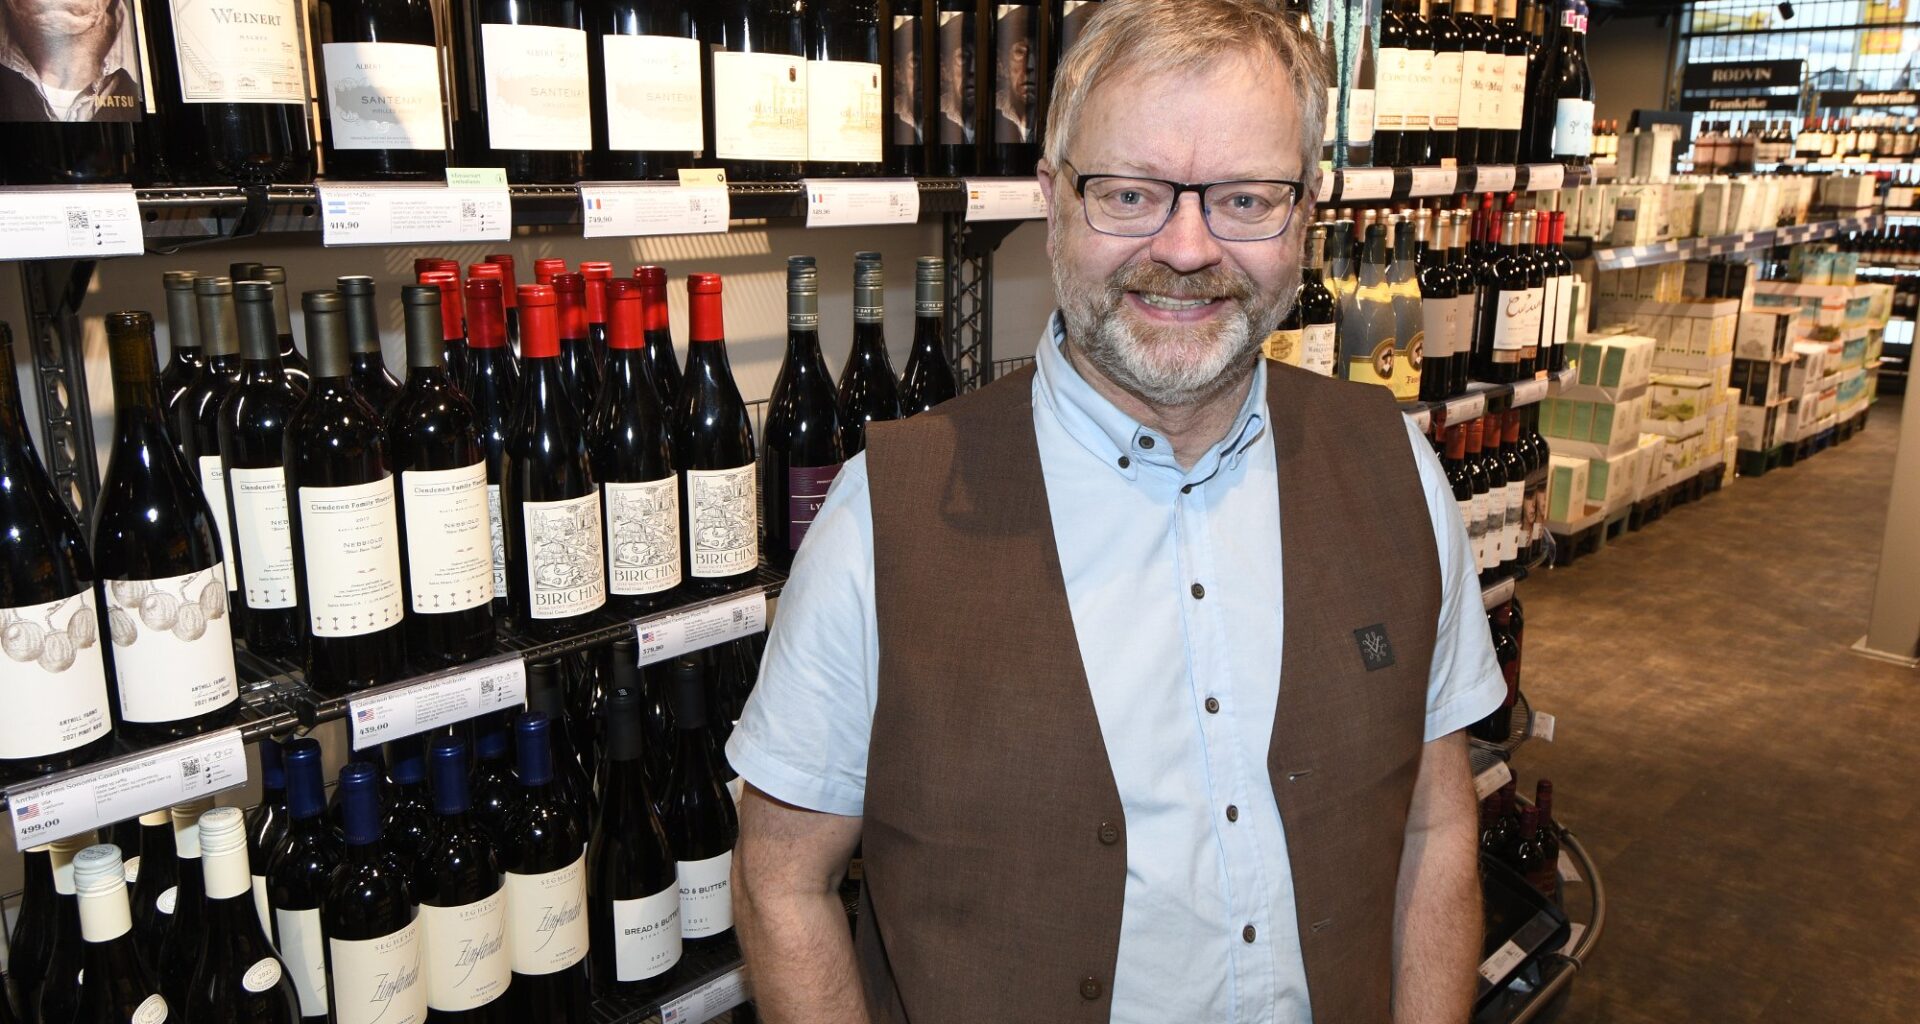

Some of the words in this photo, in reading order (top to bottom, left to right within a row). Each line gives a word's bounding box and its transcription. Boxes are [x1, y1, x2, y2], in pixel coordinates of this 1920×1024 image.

[210, 7, 282, 27] WEINERT
[95, 95, 135, 109] MATSU
[21, 818, 60, 835] 499,00
[698, 880, 727, 894] BUTTER
[624, 924, 653, 936] BREAD
